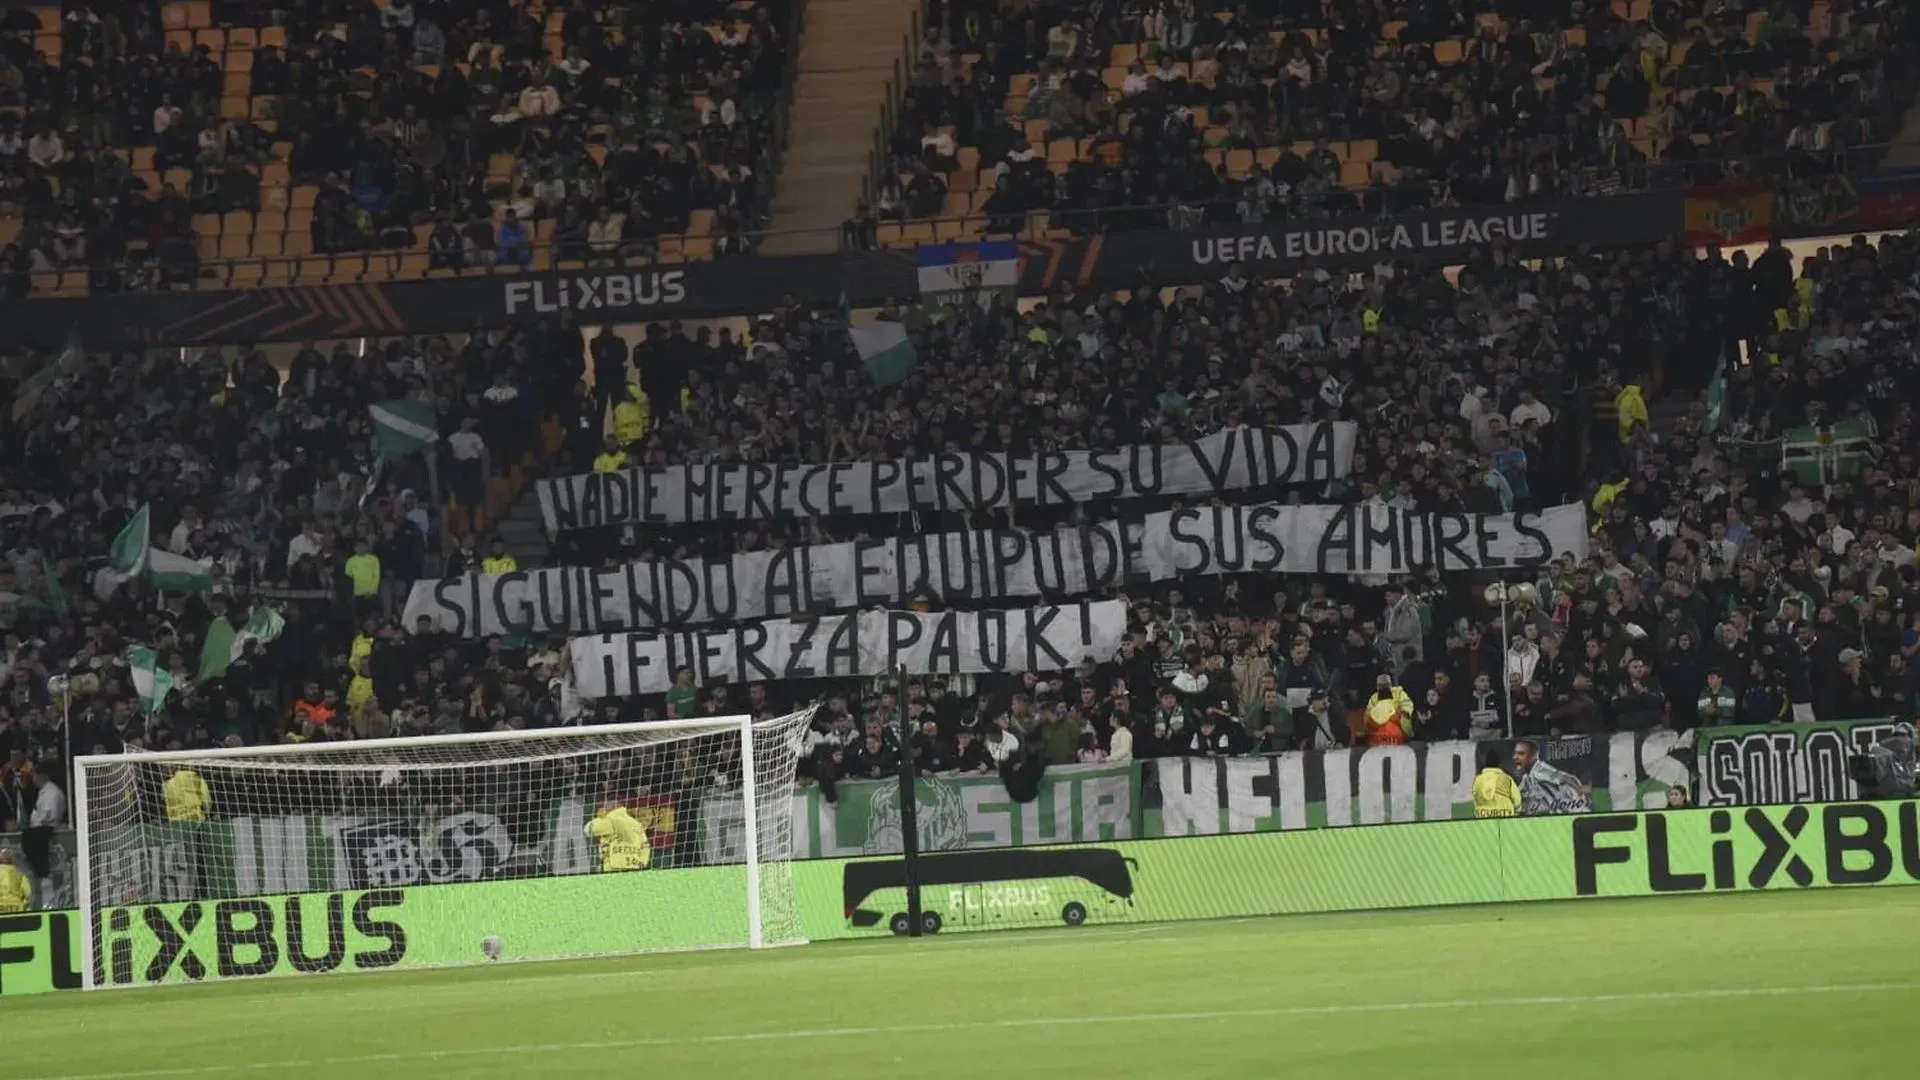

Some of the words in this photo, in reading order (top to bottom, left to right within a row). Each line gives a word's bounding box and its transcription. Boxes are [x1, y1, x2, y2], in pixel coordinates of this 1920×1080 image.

[1192, 234, 1277, 264] UEFA
[1422, 213, 1548, 247] LEAGUE
[549, 471, 667, 528] NADIE
[685, 460, 853, 522] MERECE
[871, 449, 1075, 513] PERDER
[1088, 443, 1162, 497] SU
[1186, 421, 1336, 492] VIDA
[434, 559, 736, 640] SIGUIENDO
[766, 547, 836, 616] AL
[1170, 505, 1285, 574] SUS
[1317, 503, 1553, 575] AMORES
[961, 774, 1131, 852] SUR
